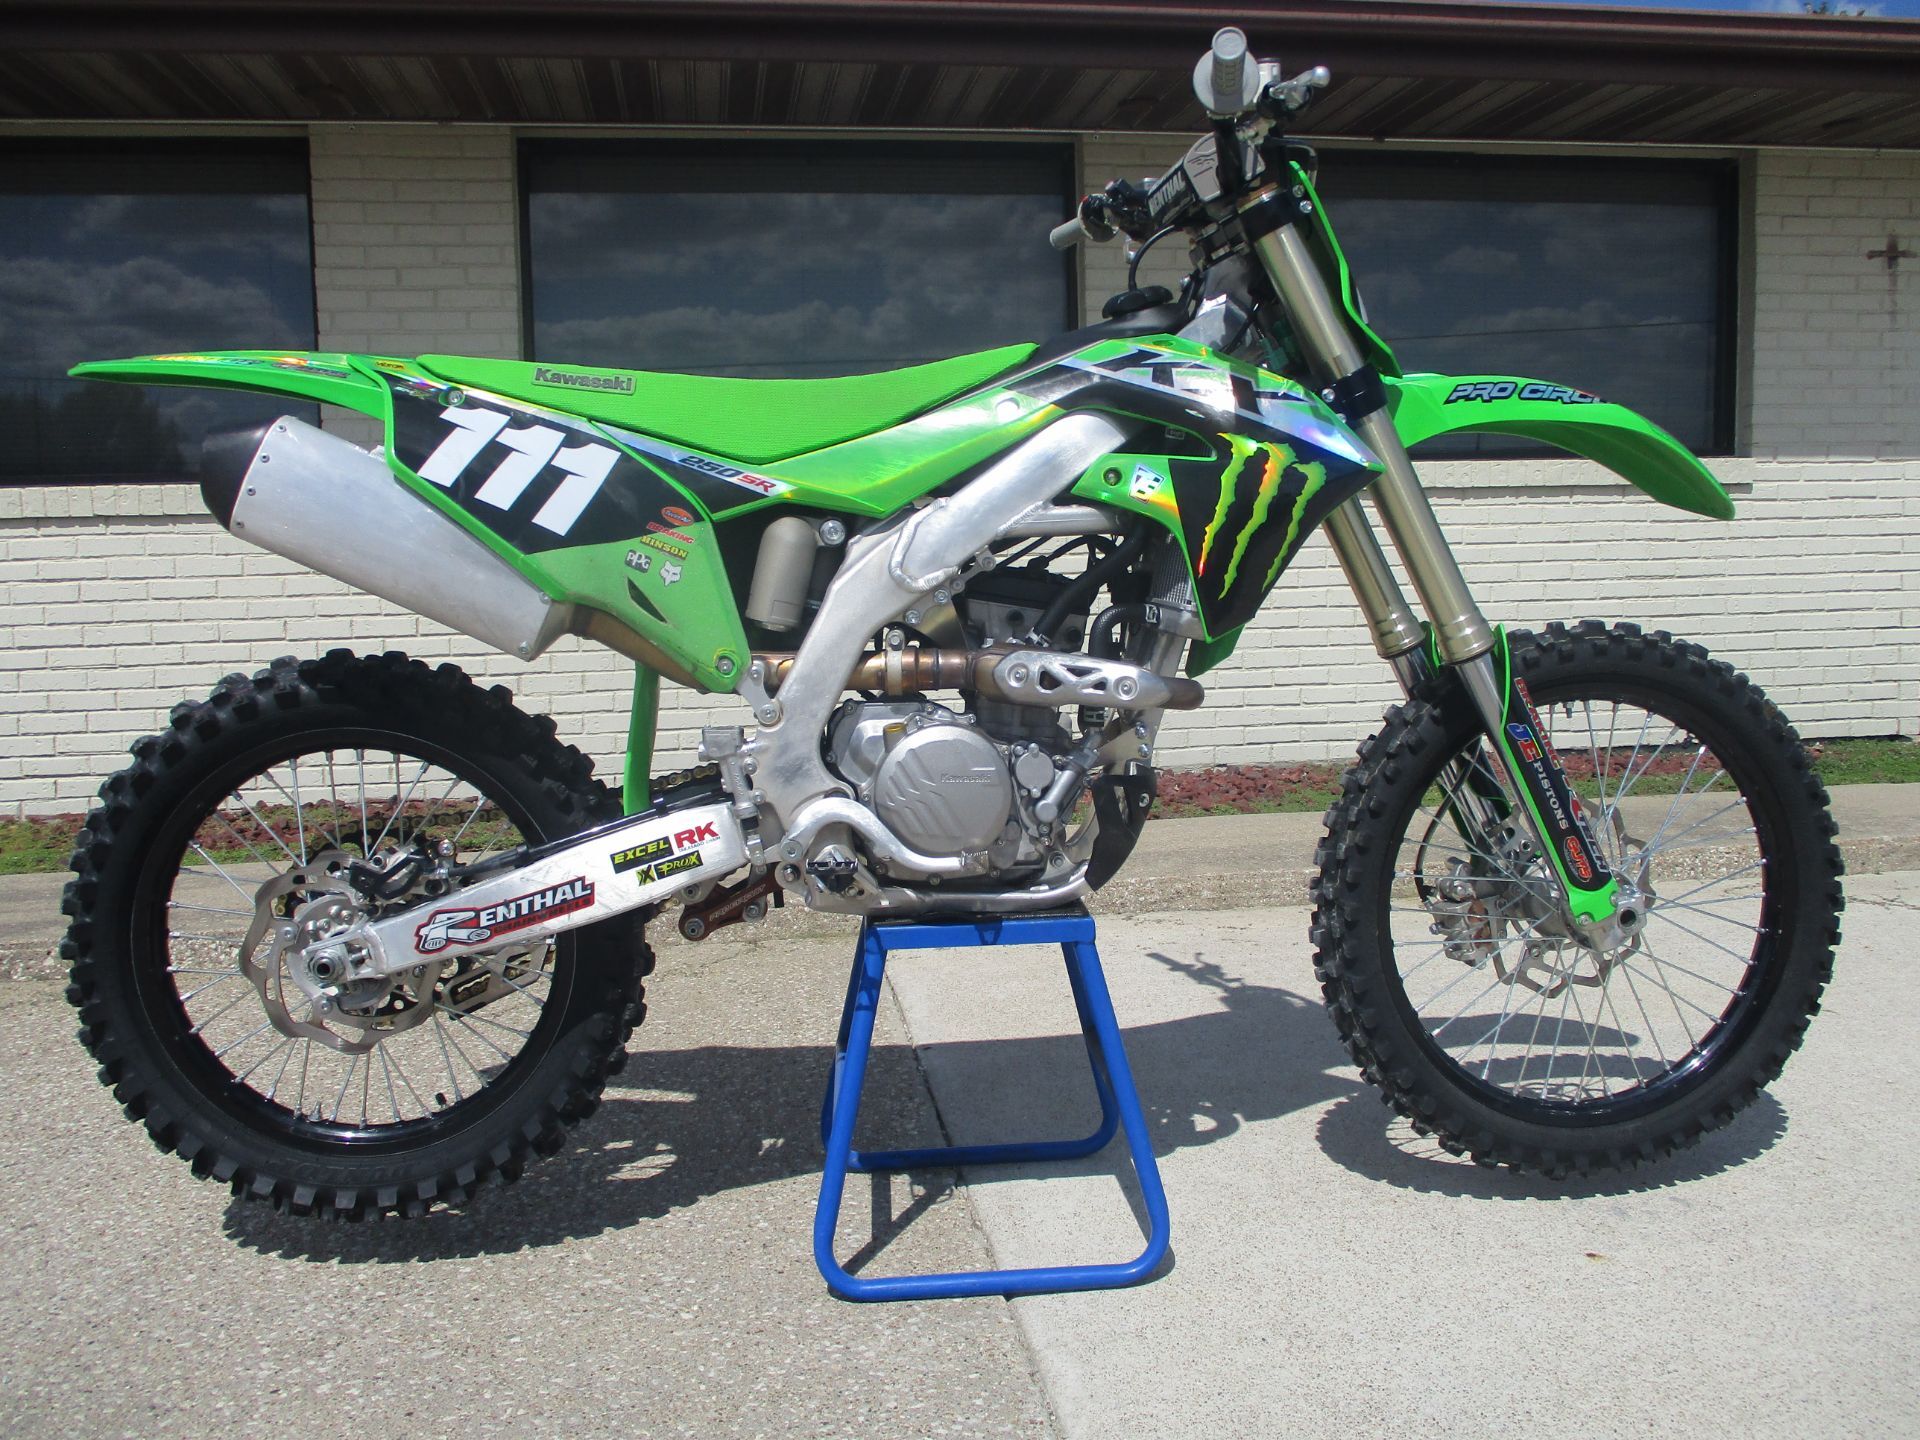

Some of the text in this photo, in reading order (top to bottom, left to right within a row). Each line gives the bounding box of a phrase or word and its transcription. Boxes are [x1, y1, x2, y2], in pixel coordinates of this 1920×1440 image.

[1147, 170, 1186, 217] RENTHAL
[535, 367, 633, 391] Kawasaki
[1444, 382, 1517, 405] PRO
[416, 405, 622, 537] 111
[646, 521, 695, 544] BRAKING
[626, 551, 651, 569] PPG
[941, 773, 991, 783] Kawasaki
[1507, 723, 1569, 830] JE PISTONS
[674, 821, 719, 849] RK
[614, 840, 669, 864] EXCEL
[1566, 836, 1593, 879] GUTS
